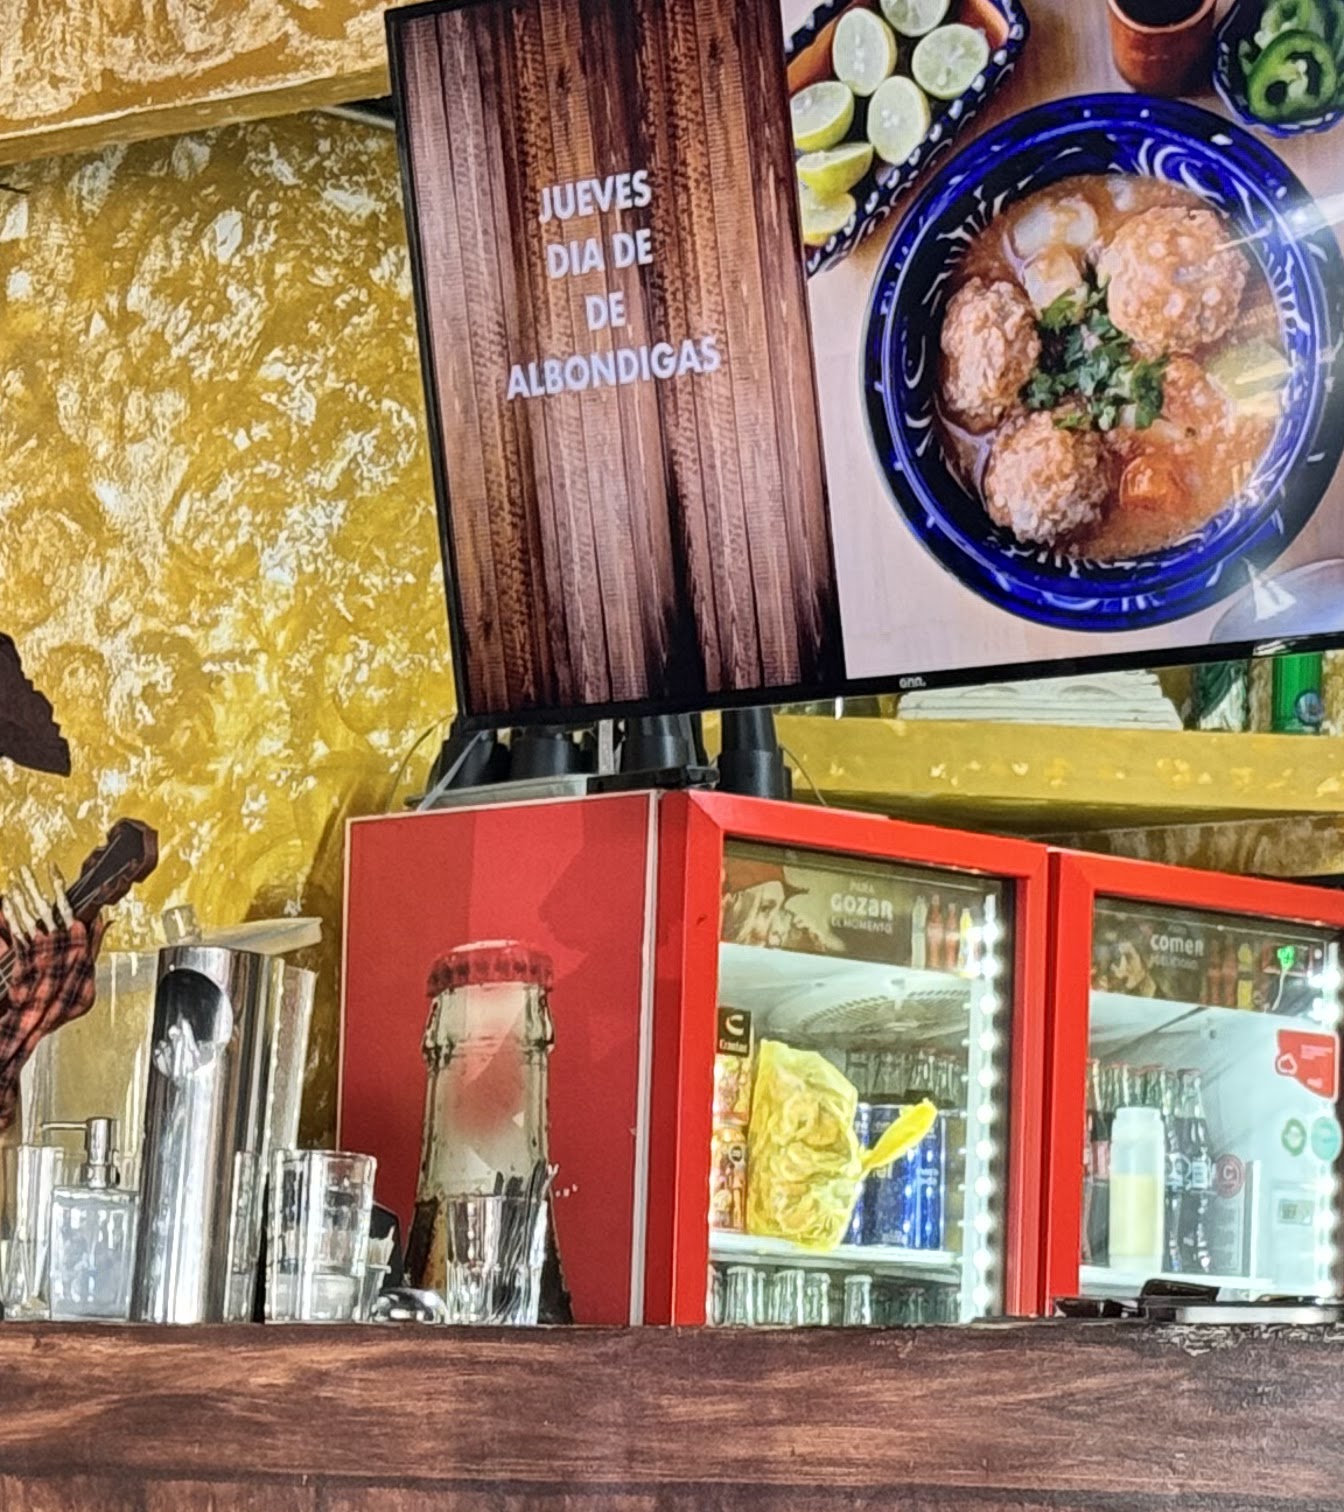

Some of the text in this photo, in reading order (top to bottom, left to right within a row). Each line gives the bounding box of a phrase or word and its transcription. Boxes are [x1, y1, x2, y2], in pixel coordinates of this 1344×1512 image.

[538, 169, 652, 225] JUEVES
[546, 228, 654, 280] DIA DE
[585, 291, 627, 332] DE
[507, 335, 721, 401] ALBONDIGAS
